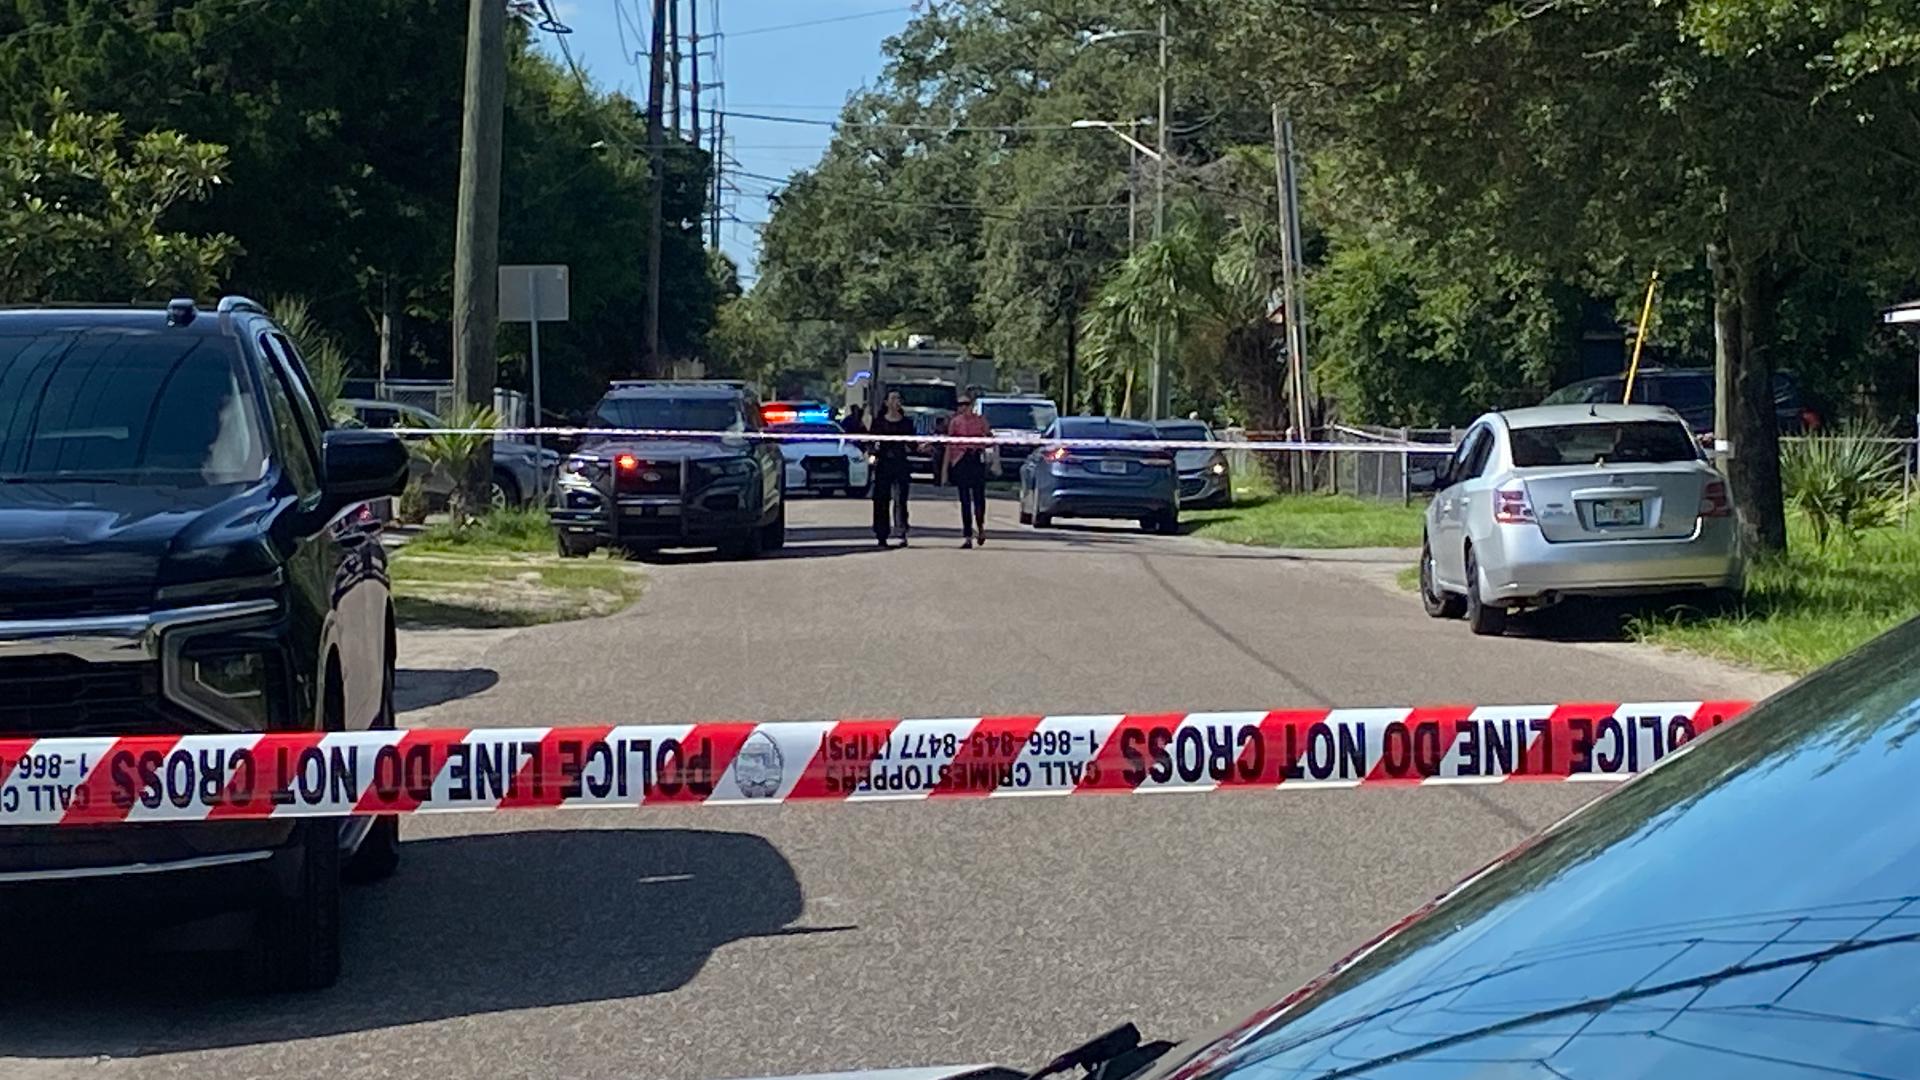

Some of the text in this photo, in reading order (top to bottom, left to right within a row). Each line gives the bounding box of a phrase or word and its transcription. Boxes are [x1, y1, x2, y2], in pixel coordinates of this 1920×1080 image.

[822, 729, 1099, 761] 1-866-845-8477 (TIPS)
[1120, 714, 1722, 787] OLICE LINE DO NOT CROSS
[111, 737, 714, 809] POLICE LINE DO NOT CROSS
[826, 761, 1100, 793] CALL CRIMESTOPPERS
[0, 784, 90, 813] CALL C
